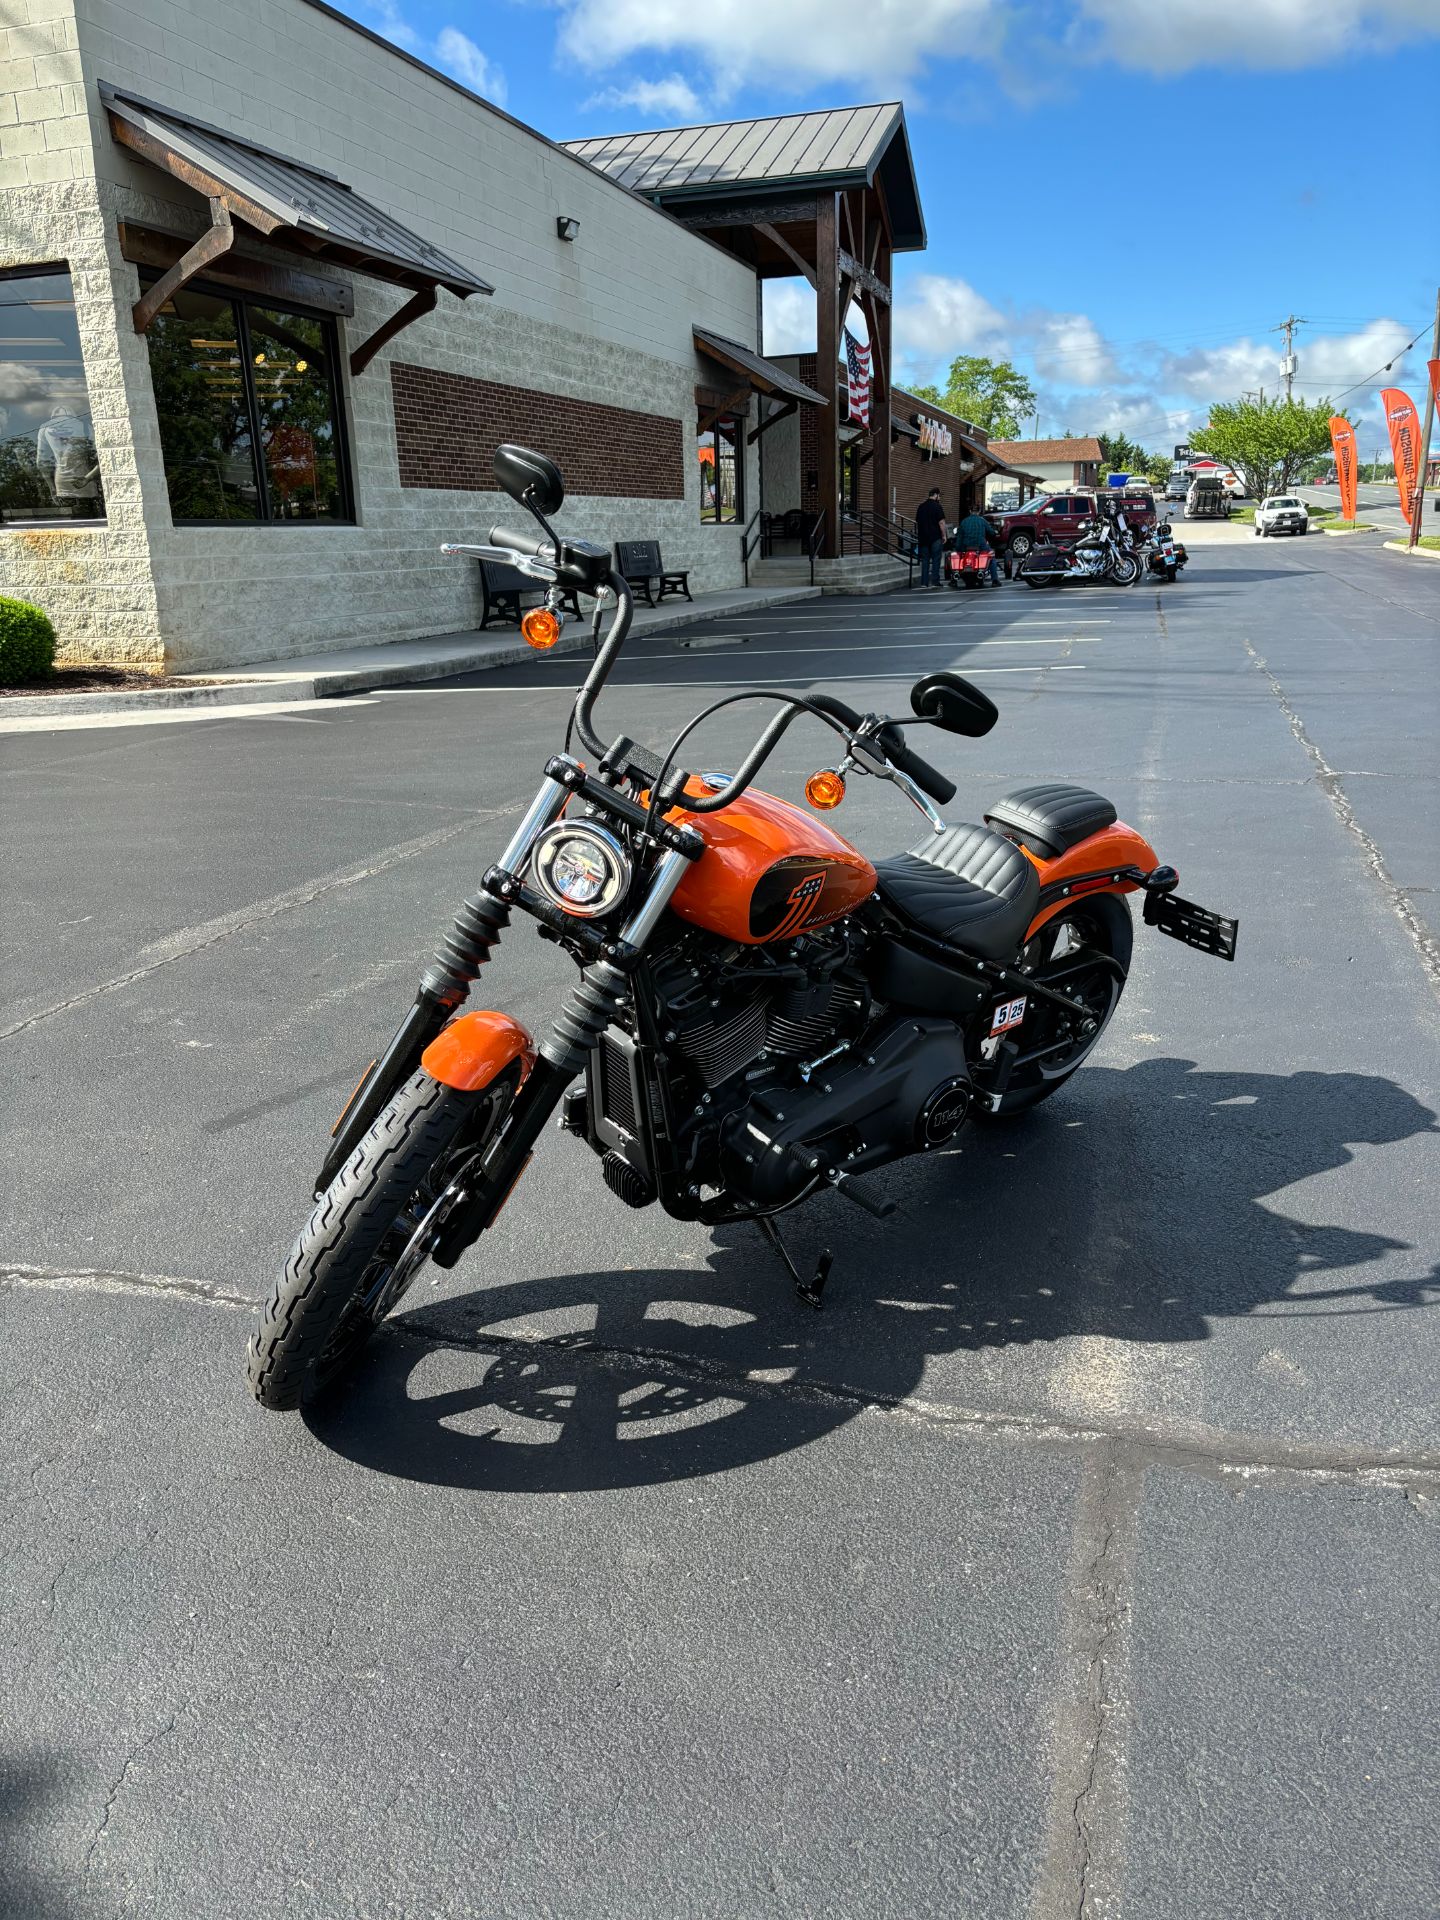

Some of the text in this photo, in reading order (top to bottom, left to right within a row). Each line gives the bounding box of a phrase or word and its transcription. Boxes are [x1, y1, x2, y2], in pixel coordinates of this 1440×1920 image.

[998, 1002, 1024, 1024] 5 25
[933, 1103, 964, 1128] 114
